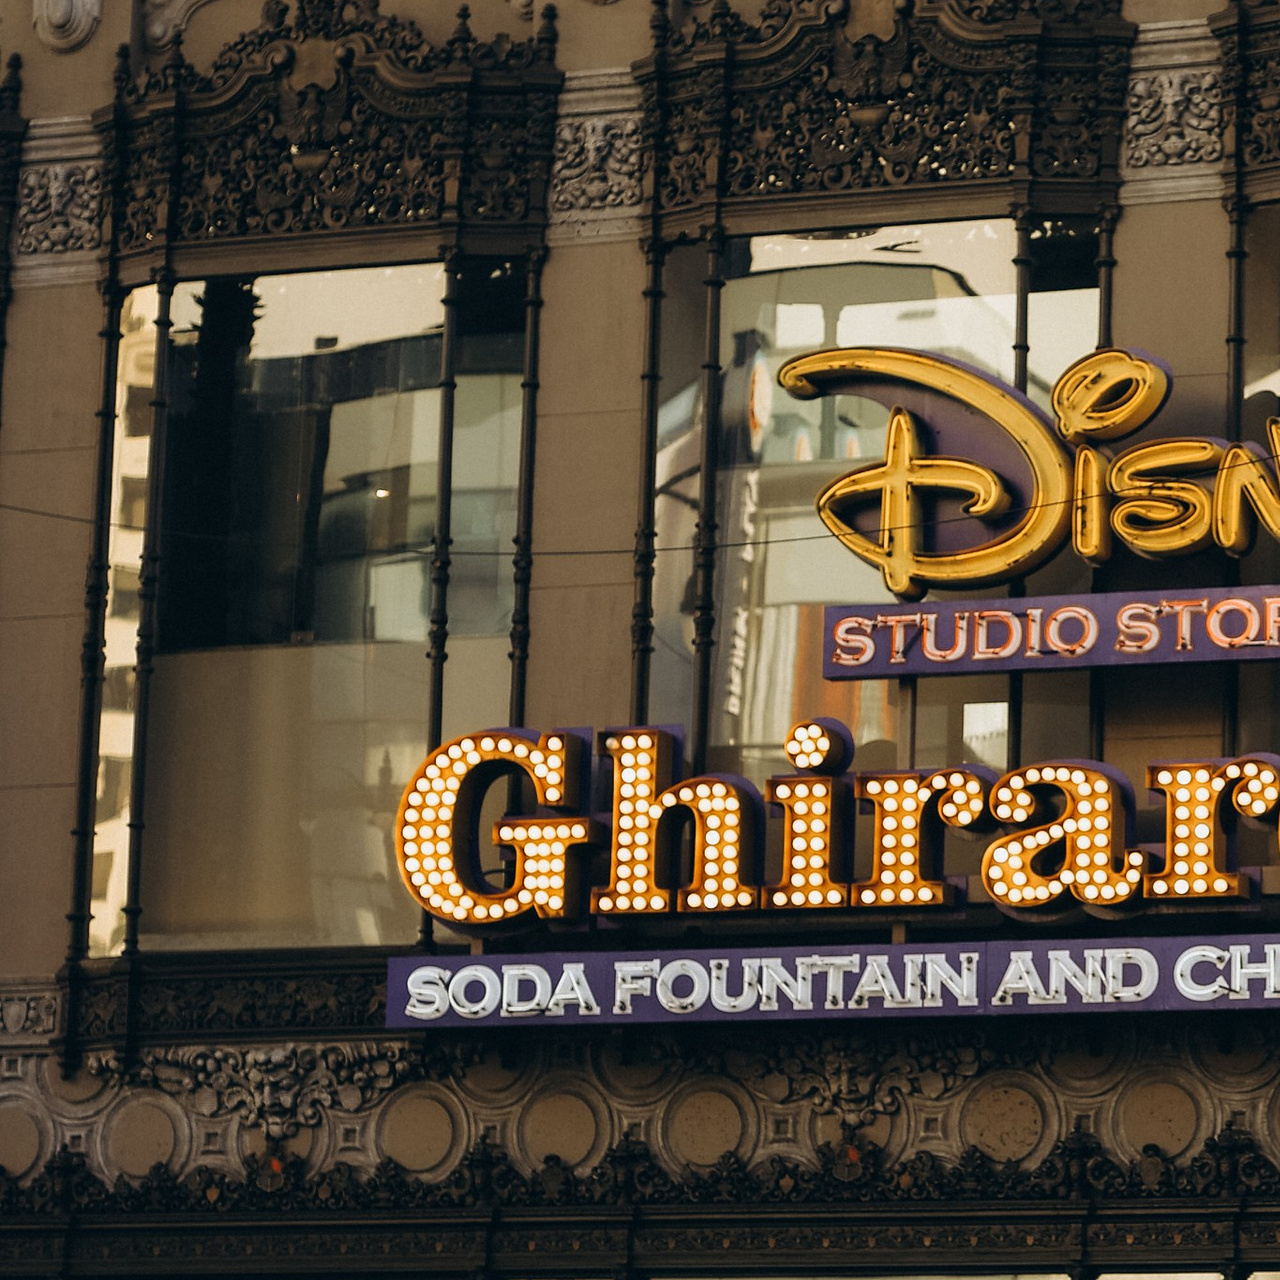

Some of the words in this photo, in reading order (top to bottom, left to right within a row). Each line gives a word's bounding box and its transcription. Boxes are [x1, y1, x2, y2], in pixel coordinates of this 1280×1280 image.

[831, 605, 1100, 668] STUDIO
[404, 961, 601, 1020] SODA
[612, 951, 980, 1016] FOUNTAIN
[991, 946, 1160, 1007] AND
